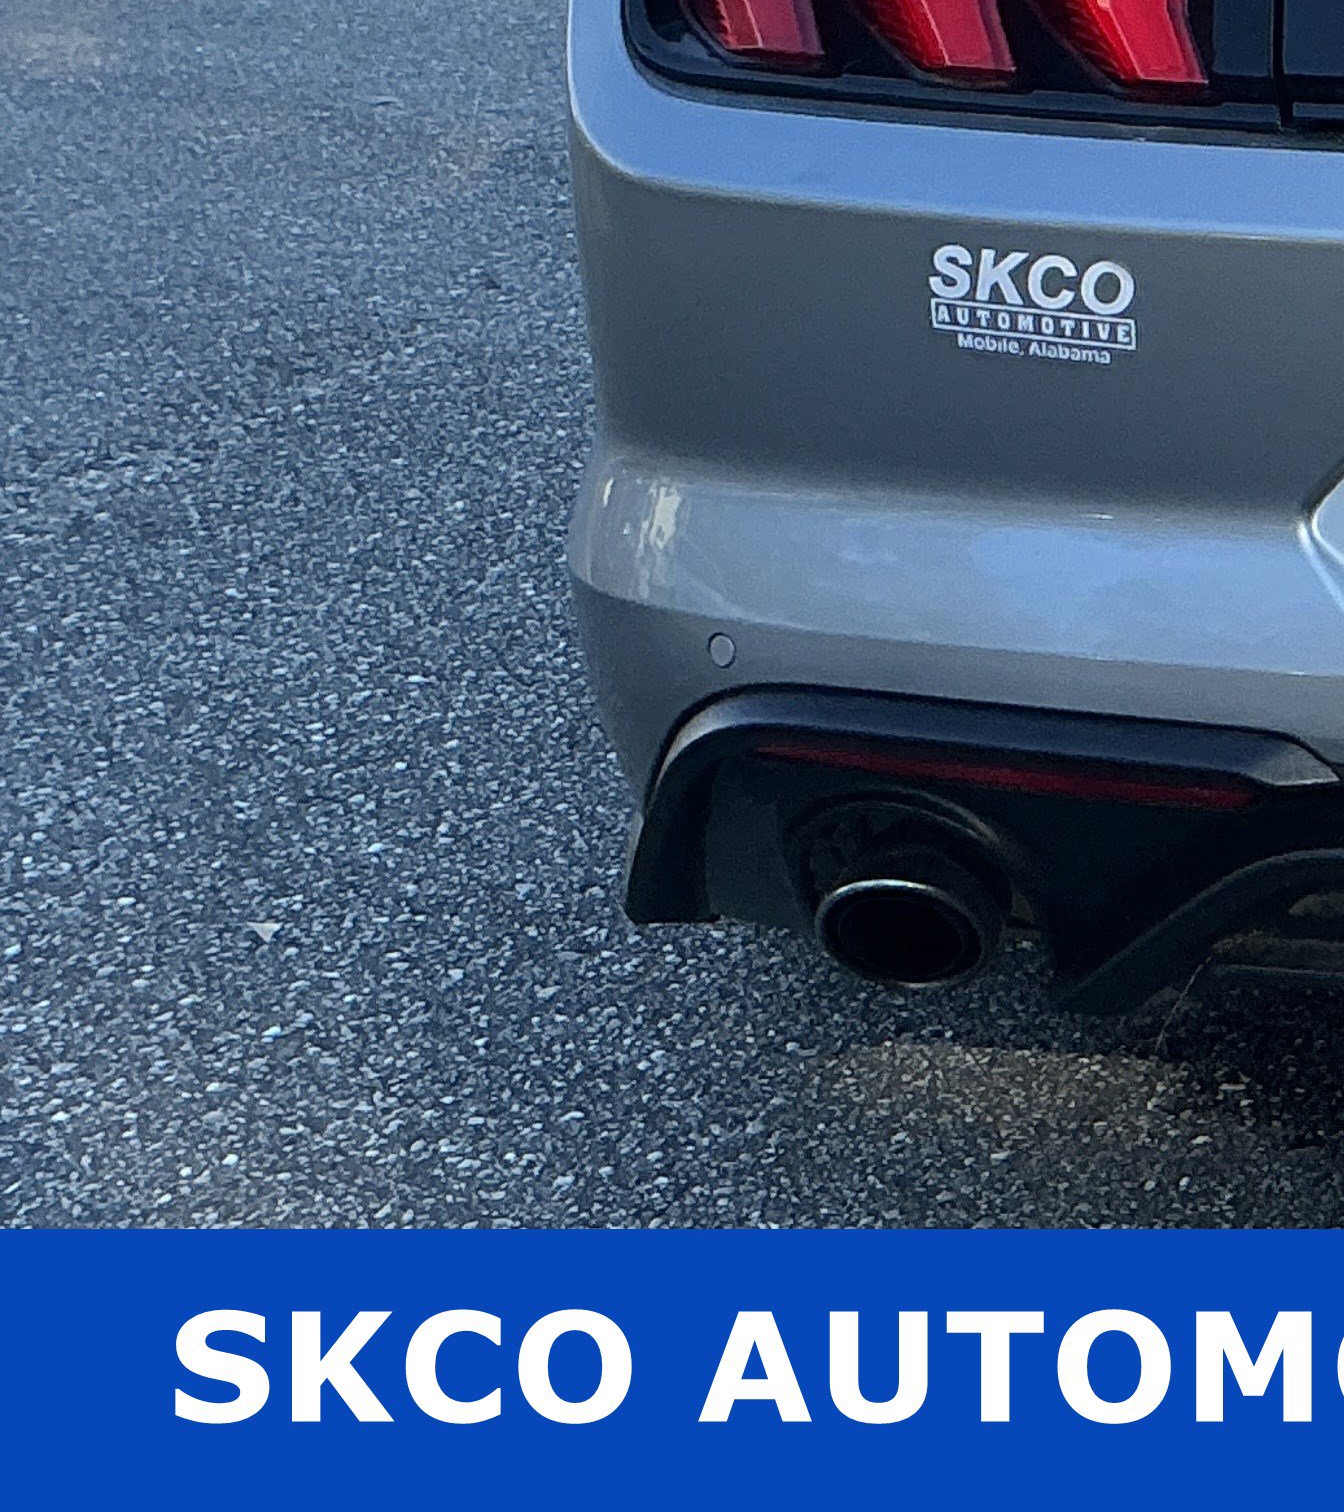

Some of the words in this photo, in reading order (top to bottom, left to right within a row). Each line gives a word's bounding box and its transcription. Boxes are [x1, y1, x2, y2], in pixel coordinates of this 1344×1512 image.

[928, 244, 1136, 315] SKCO
[936, 305, 1131, 343] AUTOMOTIVE
[957, 333, 1025, 356] Mobile,
[1029, 343, 1111, 365] Alabama
